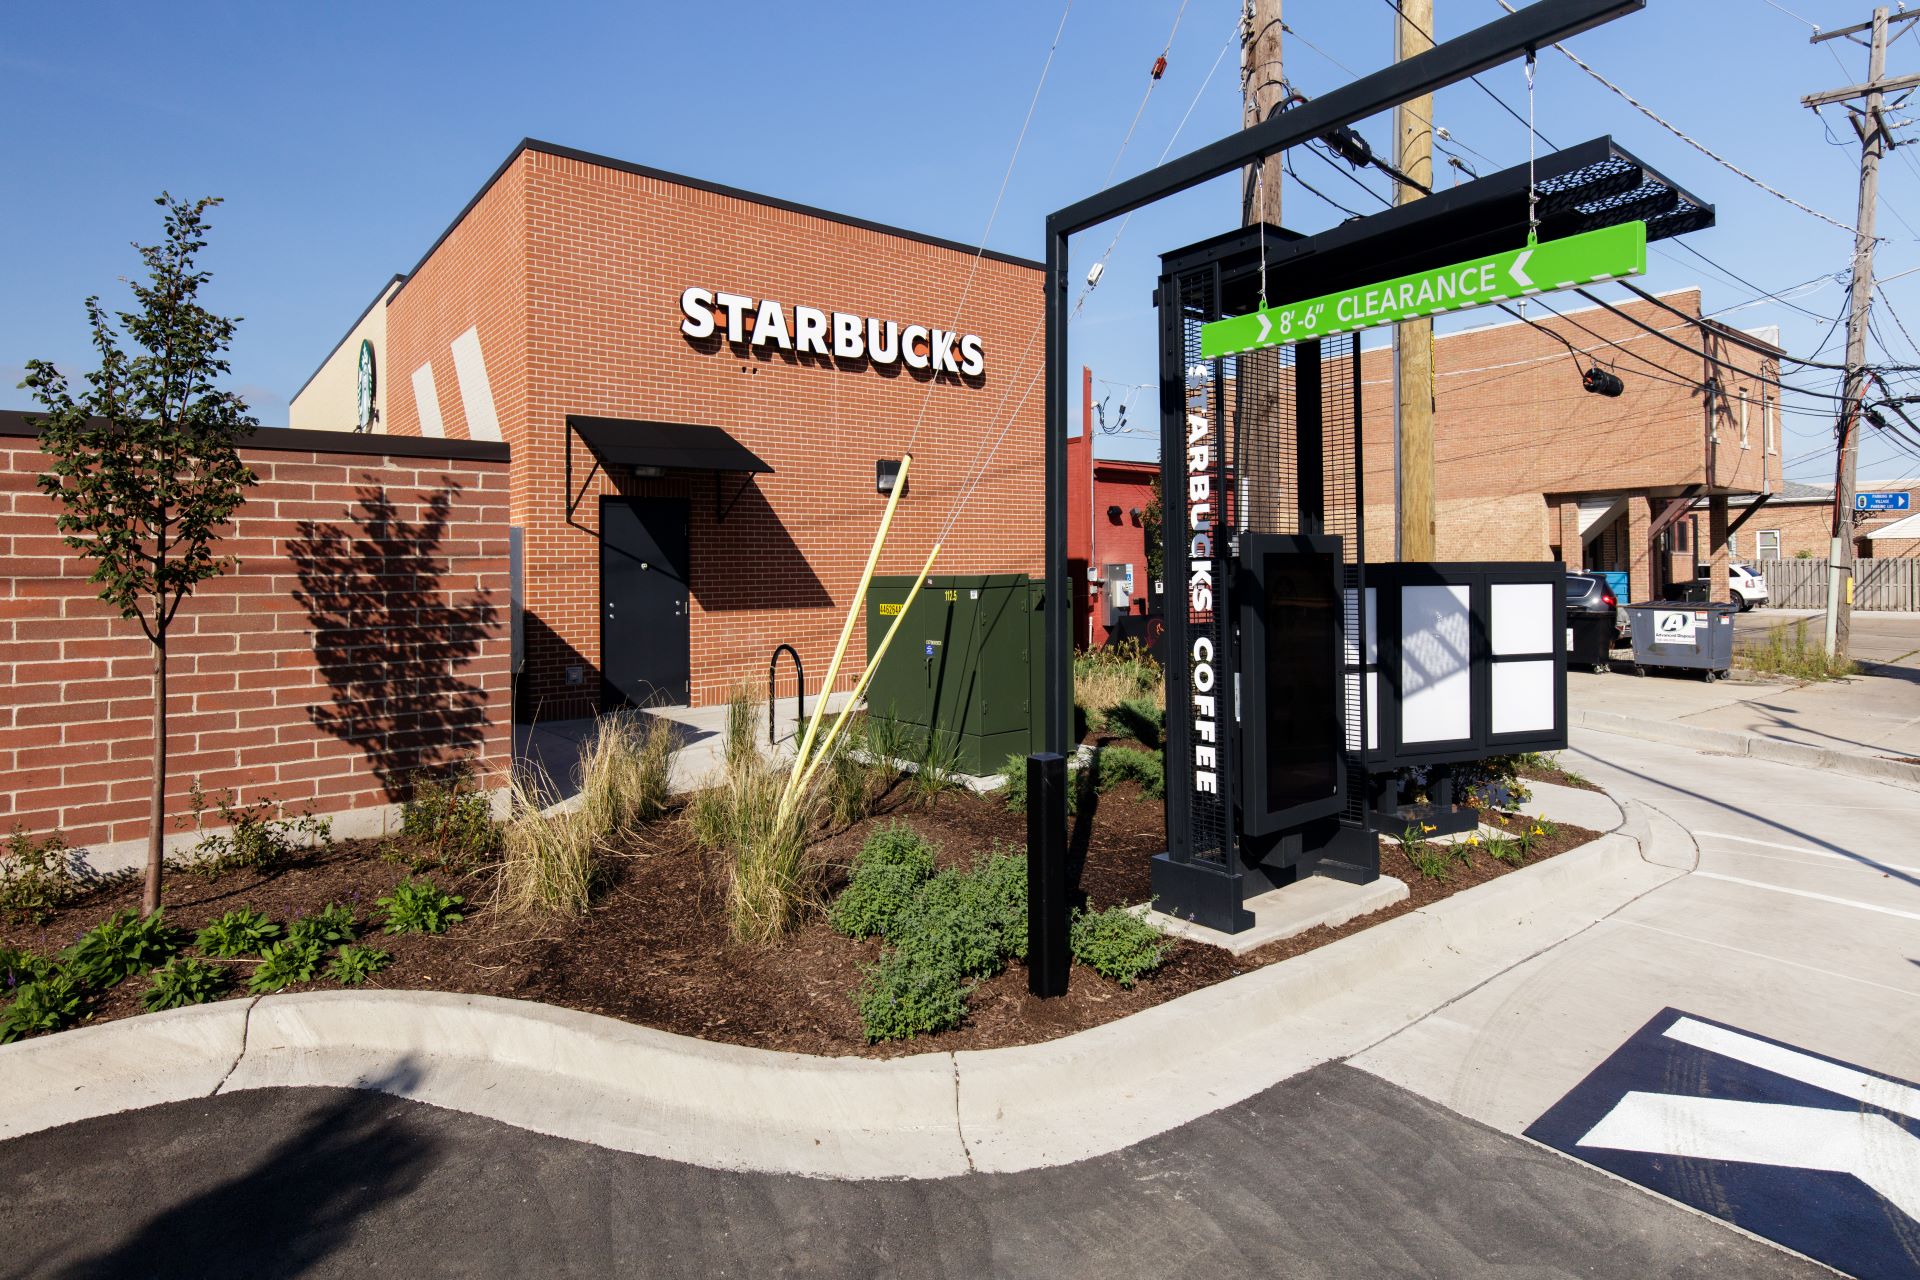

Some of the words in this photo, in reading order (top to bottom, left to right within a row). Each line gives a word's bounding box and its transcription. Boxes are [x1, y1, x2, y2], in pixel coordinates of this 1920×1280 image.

[680, 287, 984, 376] STARBUCKS
[1337, 263, 1496, 322] CLEARANCE
[1188, 364, 1213, 612] STARBUCKS
[1193, 636, 1217, 795] COFFEE
